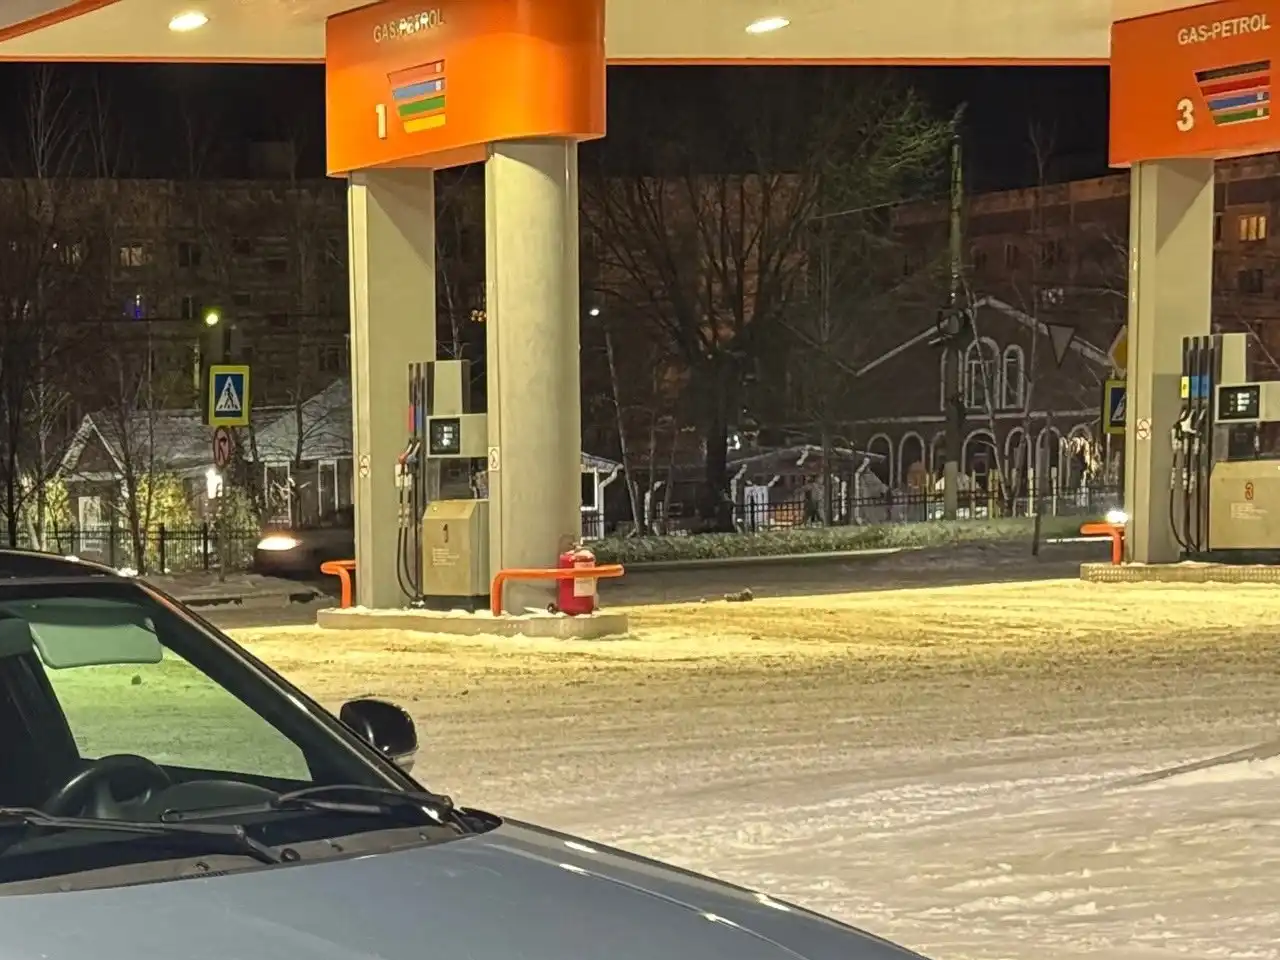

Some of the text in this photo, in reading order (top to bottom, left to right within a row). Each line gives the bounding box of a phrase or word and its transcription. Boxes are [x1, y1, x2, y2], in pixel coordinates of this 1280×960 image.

[1178, 14, 1271, 45] GAS-PETROL
[375, 103, 387, 139] 1
[1176, 98, 1194, 132] 3
